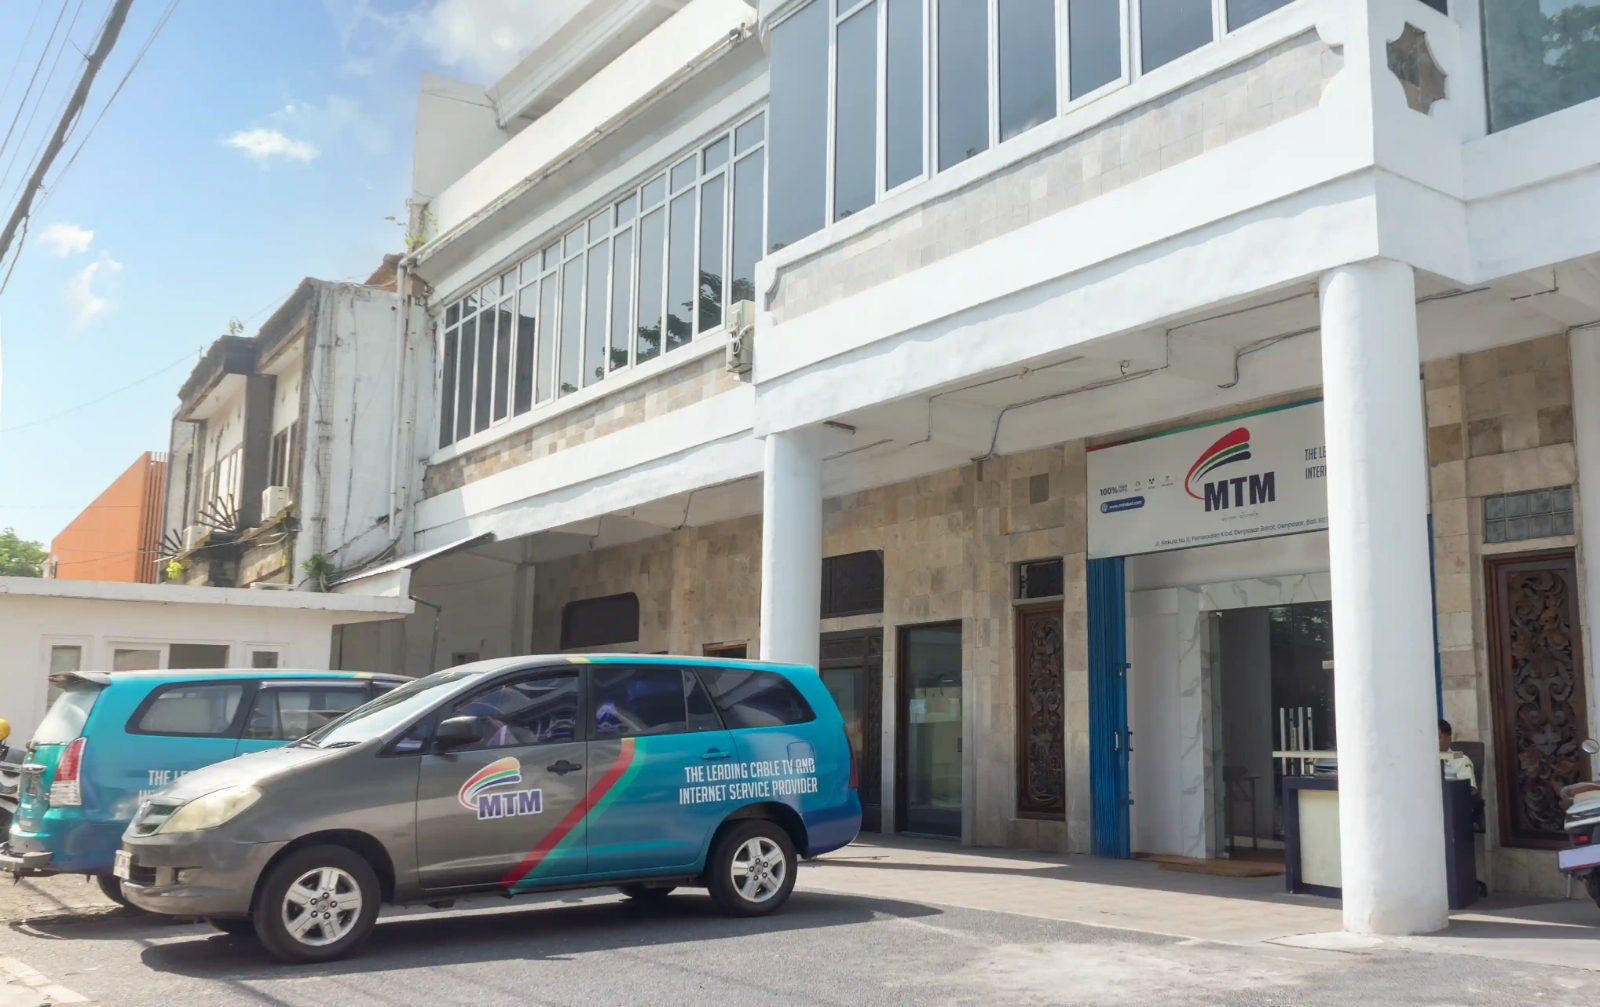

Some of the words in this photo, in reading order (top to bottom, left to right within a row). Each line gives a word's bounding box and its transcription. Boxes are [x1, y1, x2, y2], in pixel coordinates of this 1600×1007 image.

[1304, 447, 1317, 461] THE
[1305, 464, 1327, 480] INTER
[1100, 486, 1118, 496] 100%
[1204, 471, 1276, 512] MTM
[1234, 526, 1260, 536] Denpasar
[148, 769, 171, 786] THE
[684, 766, 704, 783] THE
[706, 763, 748, 782] LEADING
[750, 760, 780, 778] CABLE
[781, 759, 793, 775] TV
[796, 758, 815, 774] AND
[679, 785, 726, 805] INTERNET
[729, 781, 770, 800] SERVICE
[772, 777, 818, 796] PROVIDER
[478, 789, 542, 820] MTM
